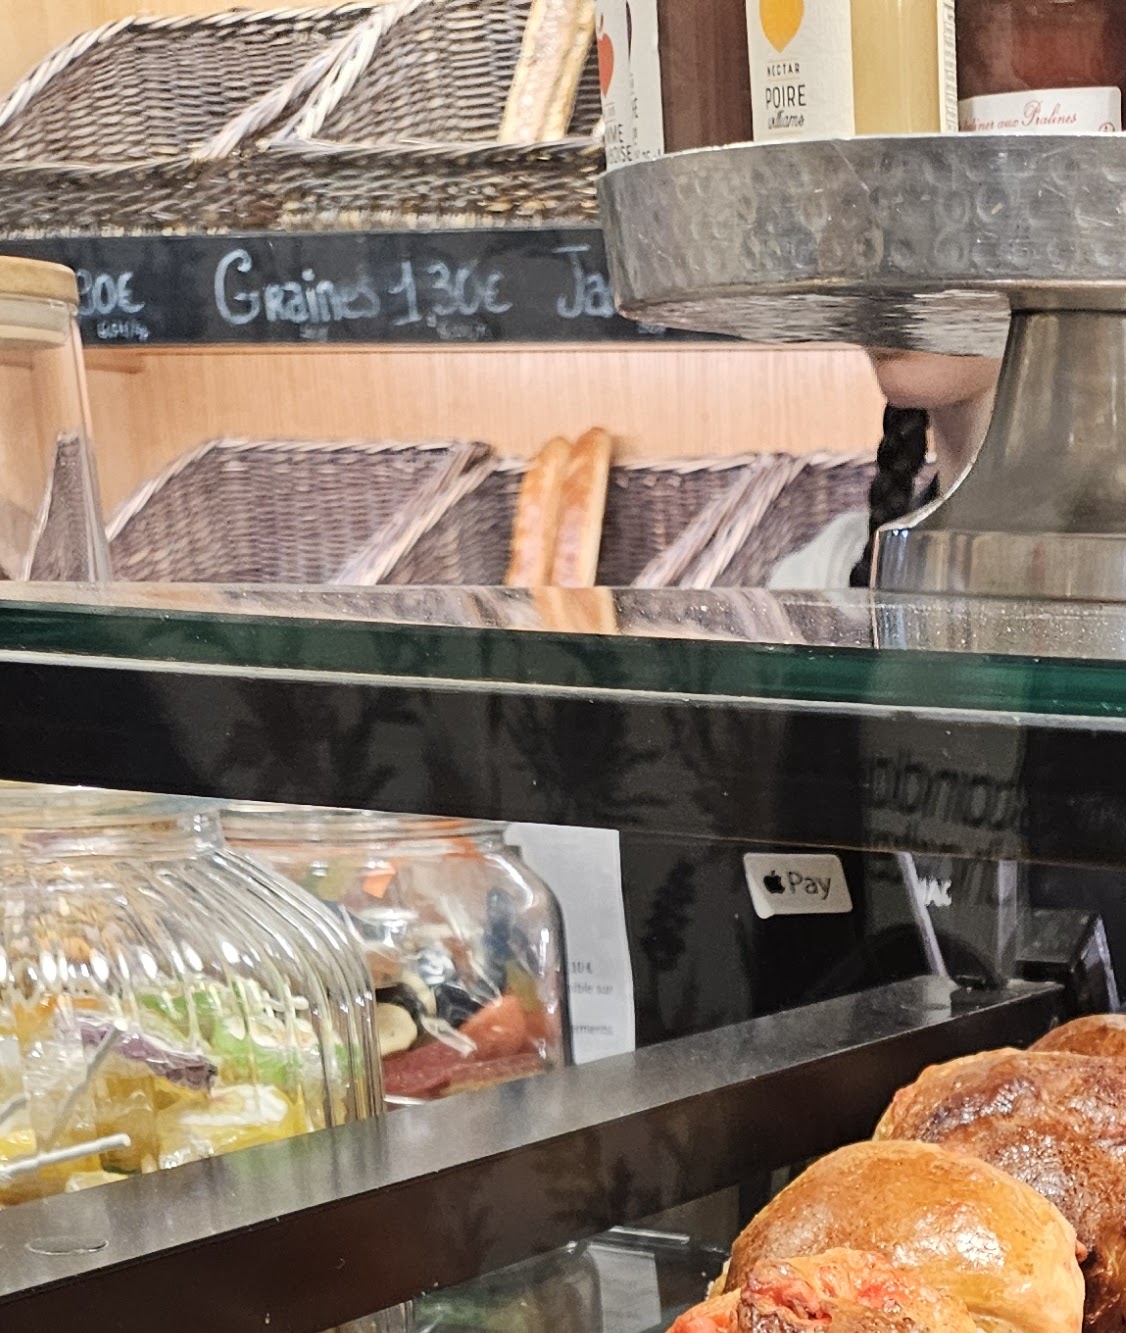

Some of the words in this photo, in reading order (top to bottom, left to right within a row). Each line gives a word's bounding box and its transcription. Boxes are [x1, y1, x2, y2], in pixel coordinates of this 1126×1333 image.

[766, 62, 800, 77] NECTAR
[765, 84, 807, 109] POIRE
[1021, 99, 1077, 127] Pralines
[787, 871, 831, 900] Pay
